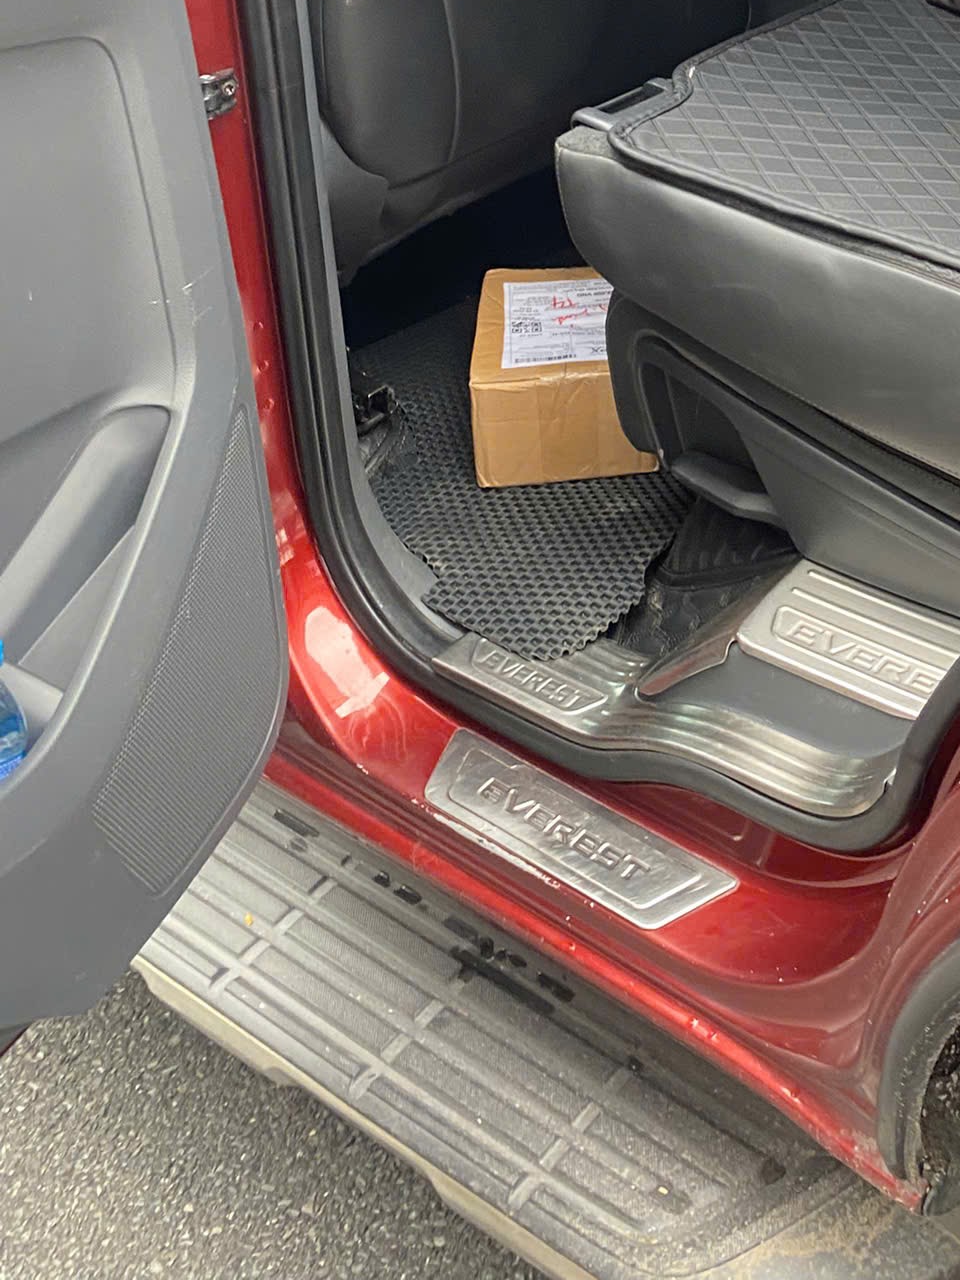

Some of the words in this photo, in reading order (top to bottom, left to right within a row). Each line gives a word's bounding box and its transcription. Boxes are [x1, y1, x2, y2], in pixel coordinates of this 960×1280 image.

[477, 650, 590, 708] EVEREST
[785, 620, 940, 695] EVERE
[477, 776, 651, 880] EVEREST
